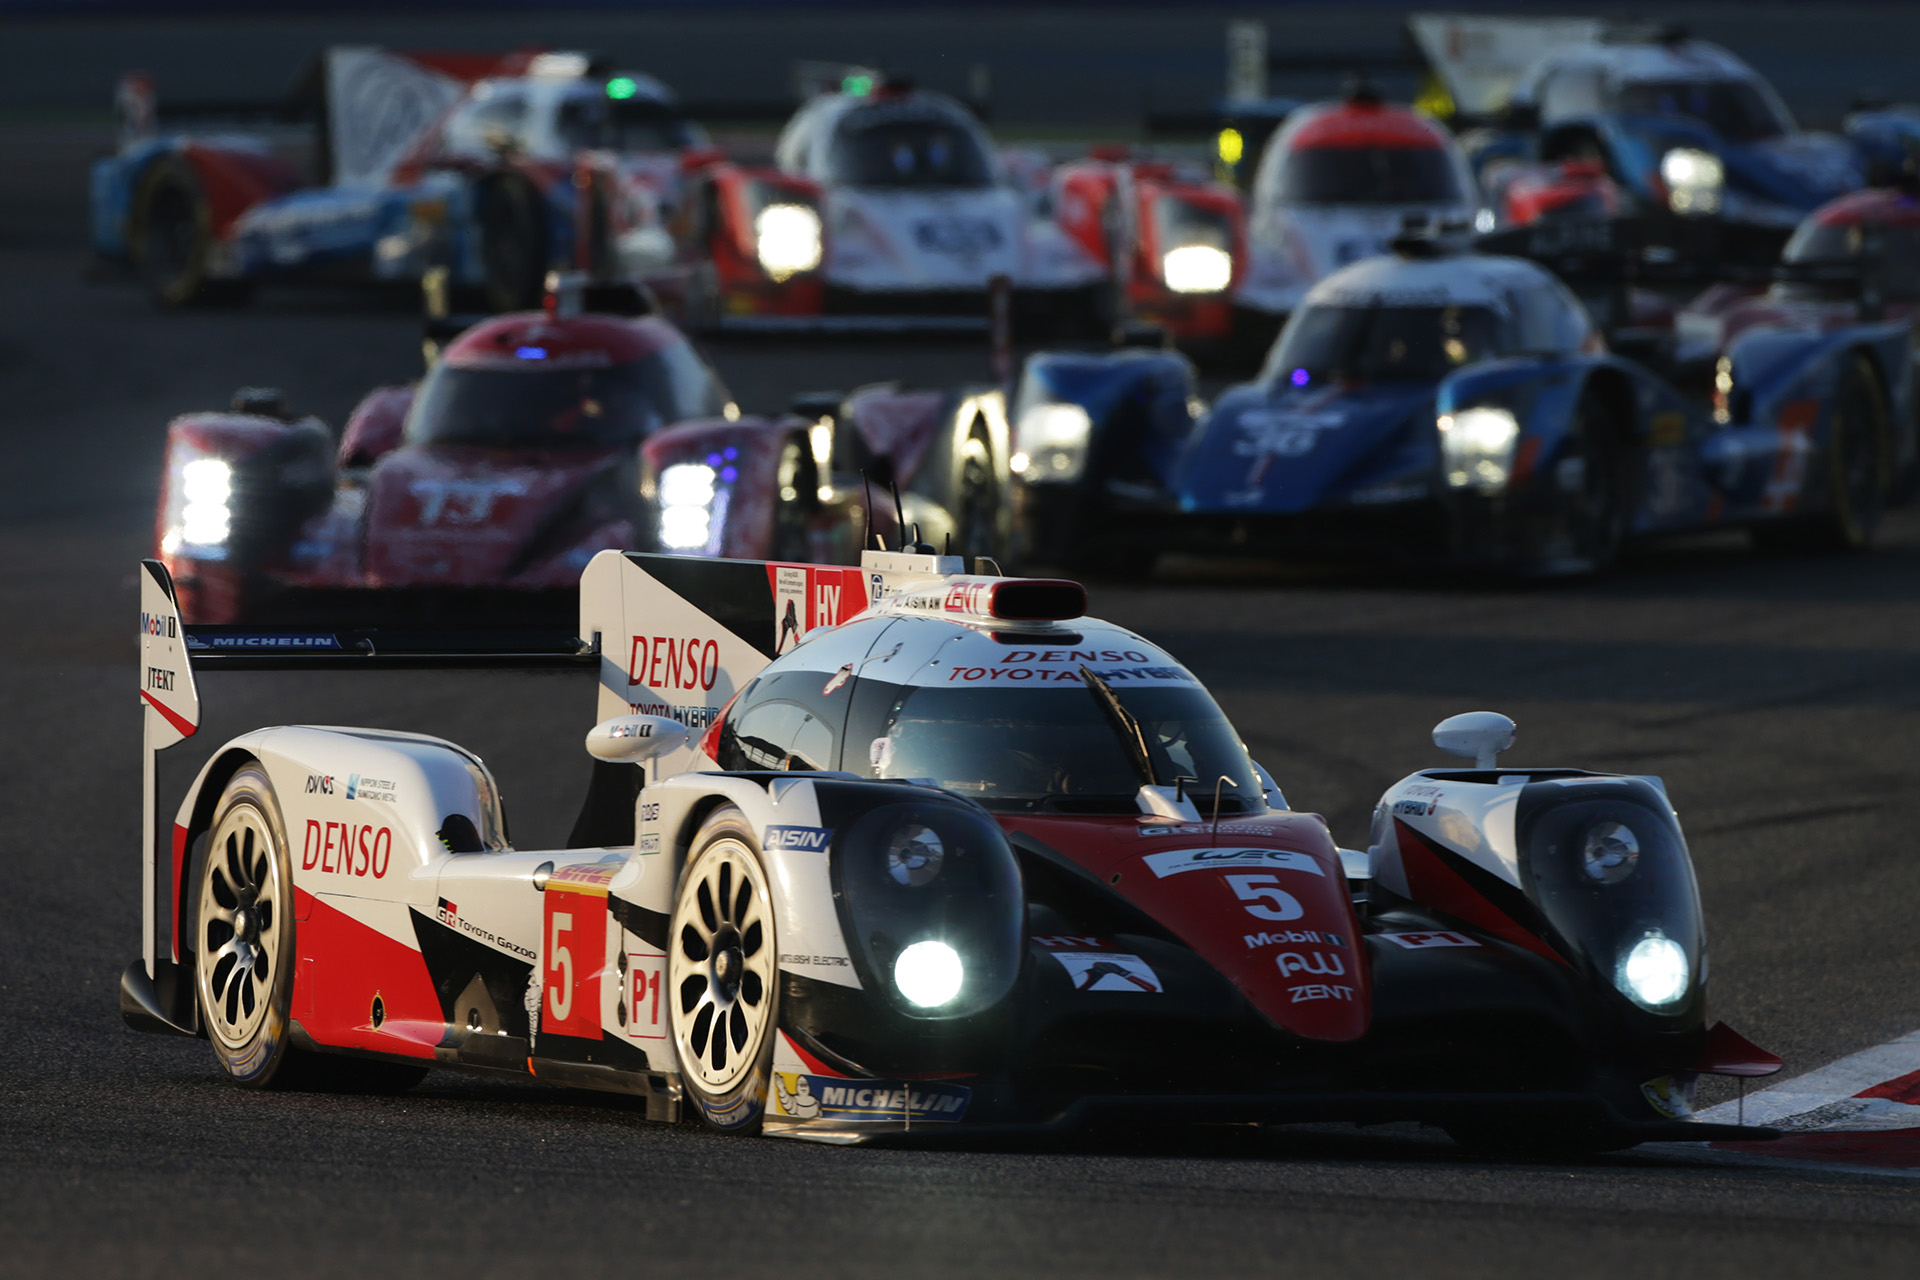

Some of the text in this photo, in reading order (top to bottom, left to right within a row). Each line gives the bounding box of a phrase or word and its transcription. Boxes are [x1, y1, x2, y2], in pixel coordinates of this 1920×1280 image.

[817, 584, 840, 627] HY
[141, 612, 176, 638] Mobil 1
[213, 637, 333, 646] MICHELIN
[628, 635, 719, 691] DENSO
[1000, 650, 1149, 664] DENSO
[147, 666, 175, 691] JTEKT
[948, 667, 1082, 682] TOYOTA
[766, 829, 826, 848] AISIN
[302, 819, 392, 879] DENSO
[1192, 850, 1292, 861] WEC
[1224, 874, 1304, 921] 5
[437, 906, 457, 928] GR
[1031, 936, 1102, 947] HY
[1243, 930, 1322, 949] Mobil
[1397, 934, 1465, 946] P1
[550, 911, 573, 1021] 5
[813, 955, 850, 967] ELECTRIC
[633, 968, 661, 1025] P1
[1287, 984, 1354, 1003] ZENT
[821, 1086, 964, 1113] MICHELIN
